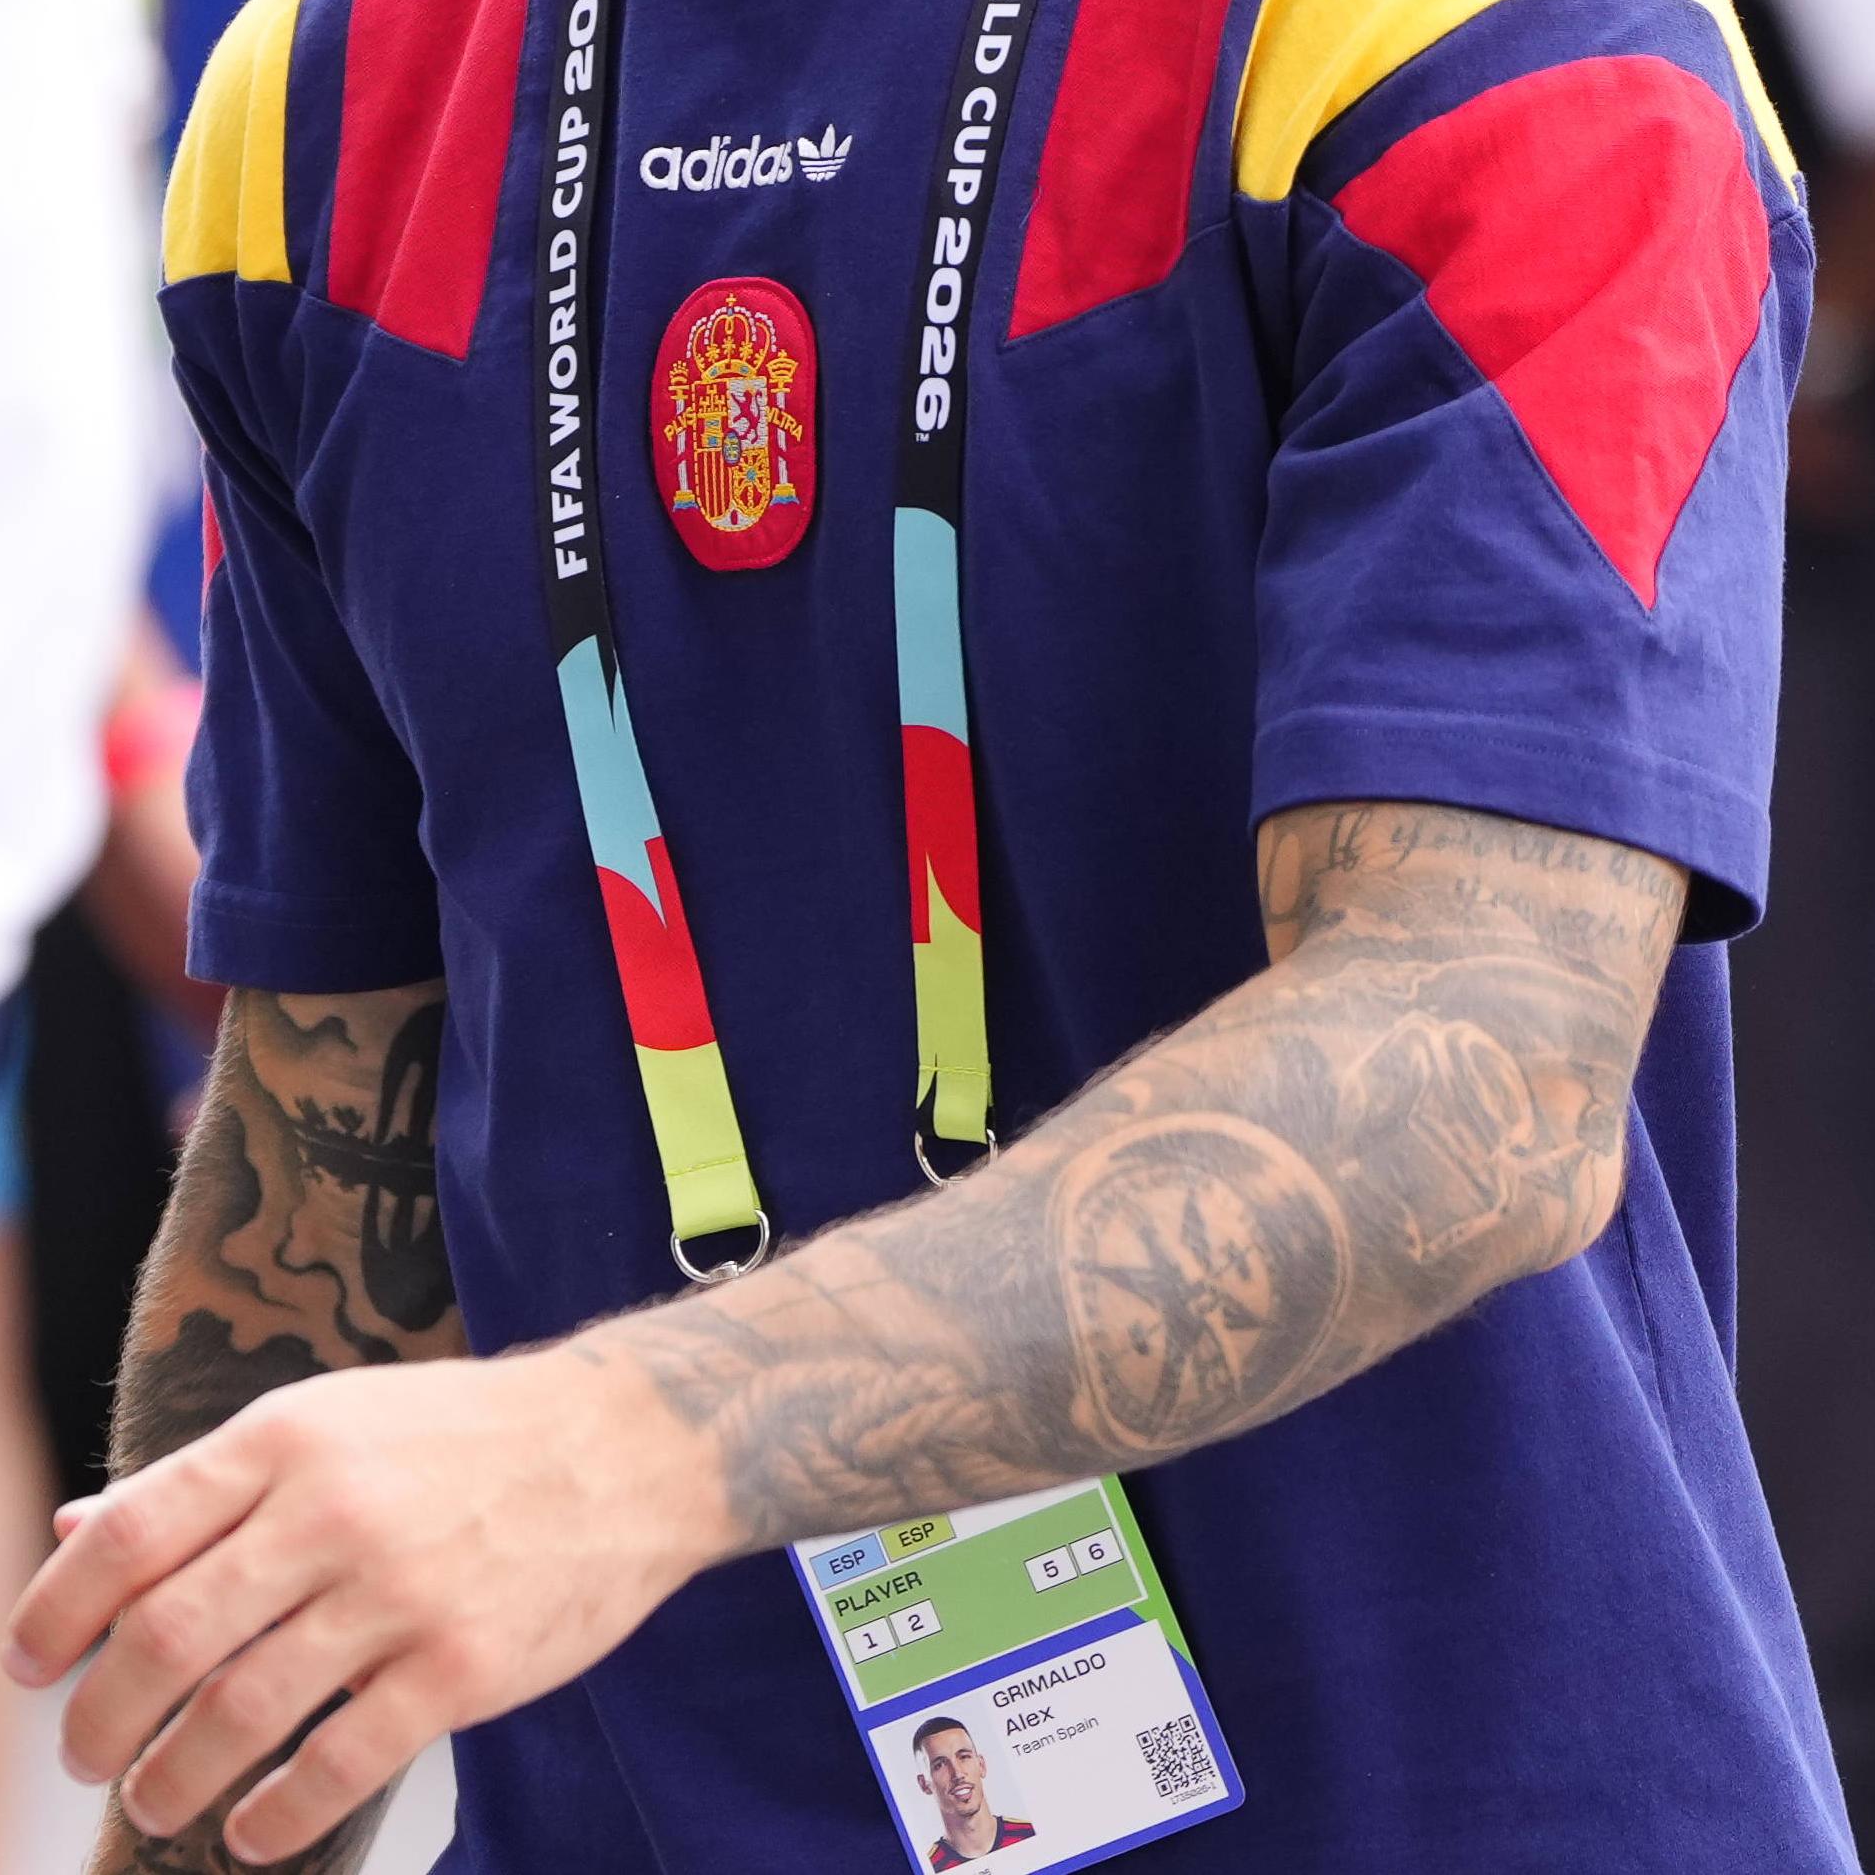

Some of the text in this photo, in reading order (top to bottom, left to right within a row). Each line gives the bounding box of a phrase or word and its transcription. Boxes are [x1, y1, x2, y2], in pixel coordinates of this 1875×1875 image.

[551, 105, 590, 219] CUP
[639, 134, 793, 192] adidas
[946, 86, 998, 206] CUP
[547, 228, 580, 446] WORLD
[550, 447, 589, 580] FIFA
[828, 1522, 935, 1575] ESP ESP
[1043, 1543, 1105, 1578] 5 6
[834, 1571, 923, 1617] PLAYER
[862, 1614, 924, 1649] 1 2
[992, 1652, 1106, 1708] GRIMALDO
[1005, 1706, 1055, 1736] Alex
[1012, 1716, 1100, 1756] Team Spain
